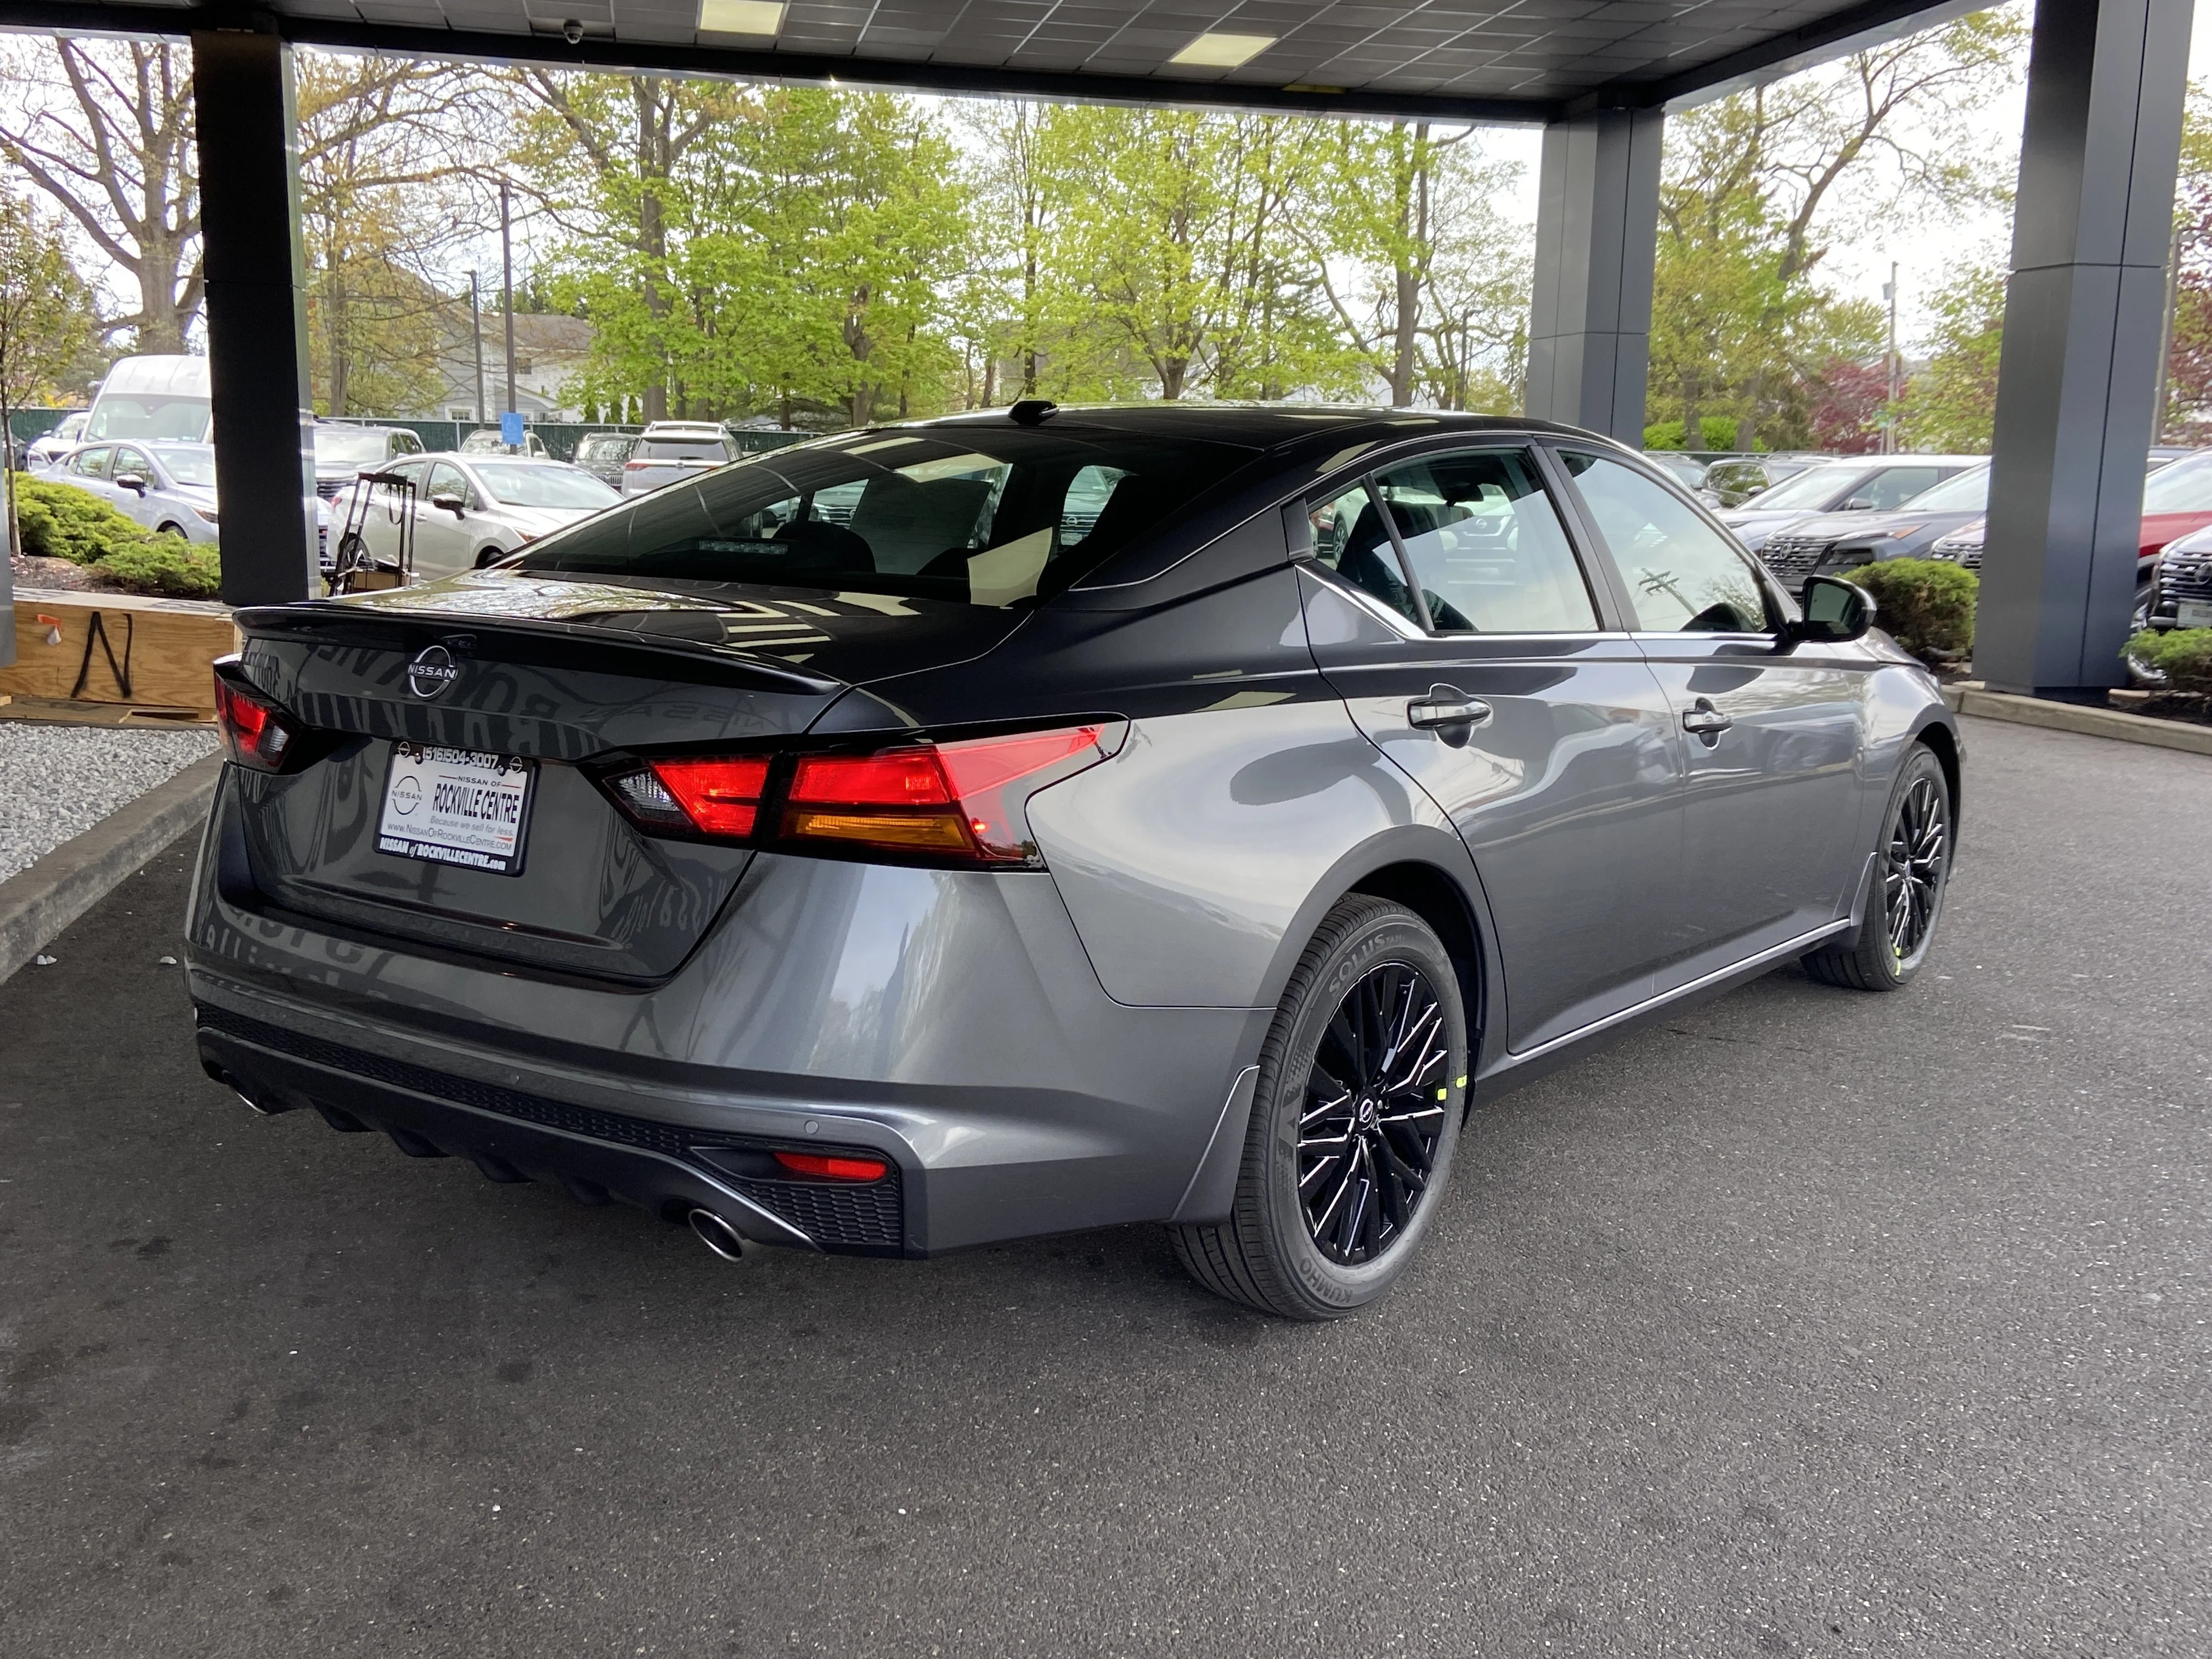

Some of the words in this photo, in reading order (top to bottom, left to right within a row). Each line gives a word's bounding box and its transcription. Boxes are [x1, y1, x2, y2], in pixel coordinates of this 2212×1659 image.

[70, 611, 133, 699] N
[408, 664, 456, 679] NISSAN
[391, 790, 422, 800] NISSAN
[457, 775, 488, 786] NISSAN
[432, 783, 483, 817] ROCKVILLE
[481, 790, 520, 823] CENTRE
[430, 816, 459, 827] Because
[471, 823, 484, 832] sell
[485, 824, 496, 833] for
[497, 826, 514, 836] less.
[379, 837, 410, 854] NISSAN
[409, 843, 419, 857] of
[416, 843, 506, 871] ROCKVILLECENTRE.com
[1328, 933, 1385, 998] SOLUS
[1300, 1257, 1353, 1304] KUMHO
